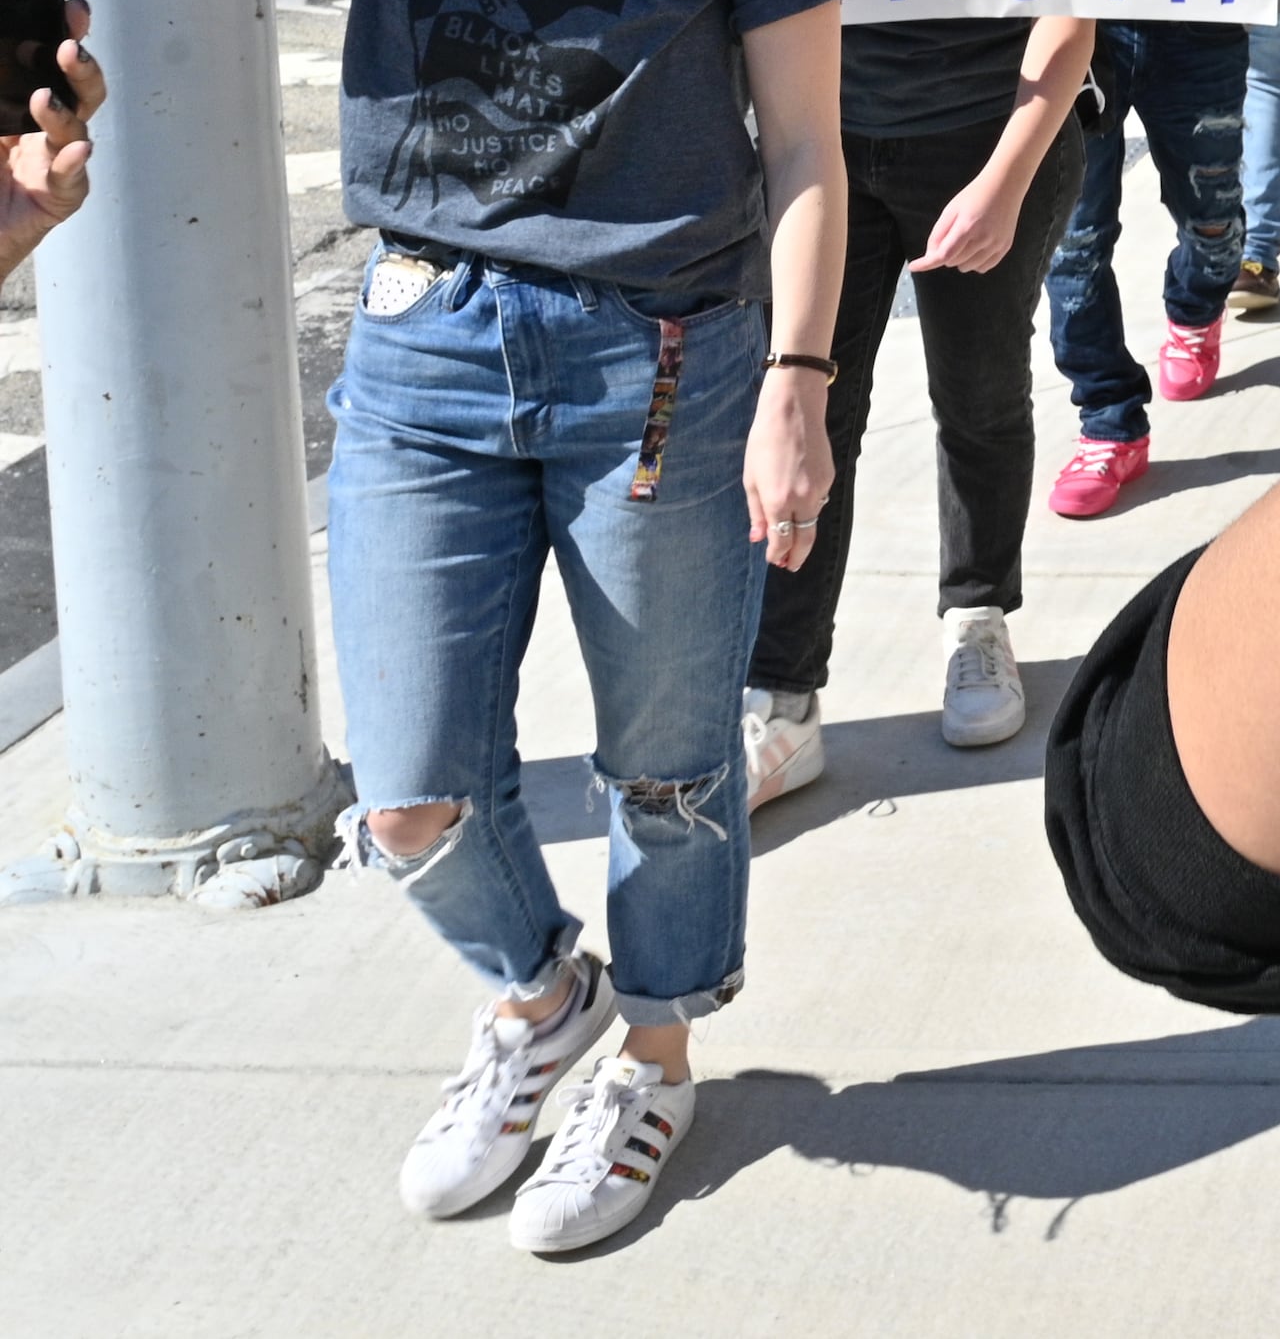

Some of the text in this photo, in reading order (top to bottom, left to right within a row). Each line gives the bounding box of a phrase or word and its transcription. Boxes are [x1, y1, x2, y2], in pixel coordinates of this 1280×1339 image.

[445, 15, 542, 64] BLACK
[480, 55, 565, 97] LIVES
[452, 133, 558, 156] JUSTICE
[490, 174, 561, 197] PEAC
